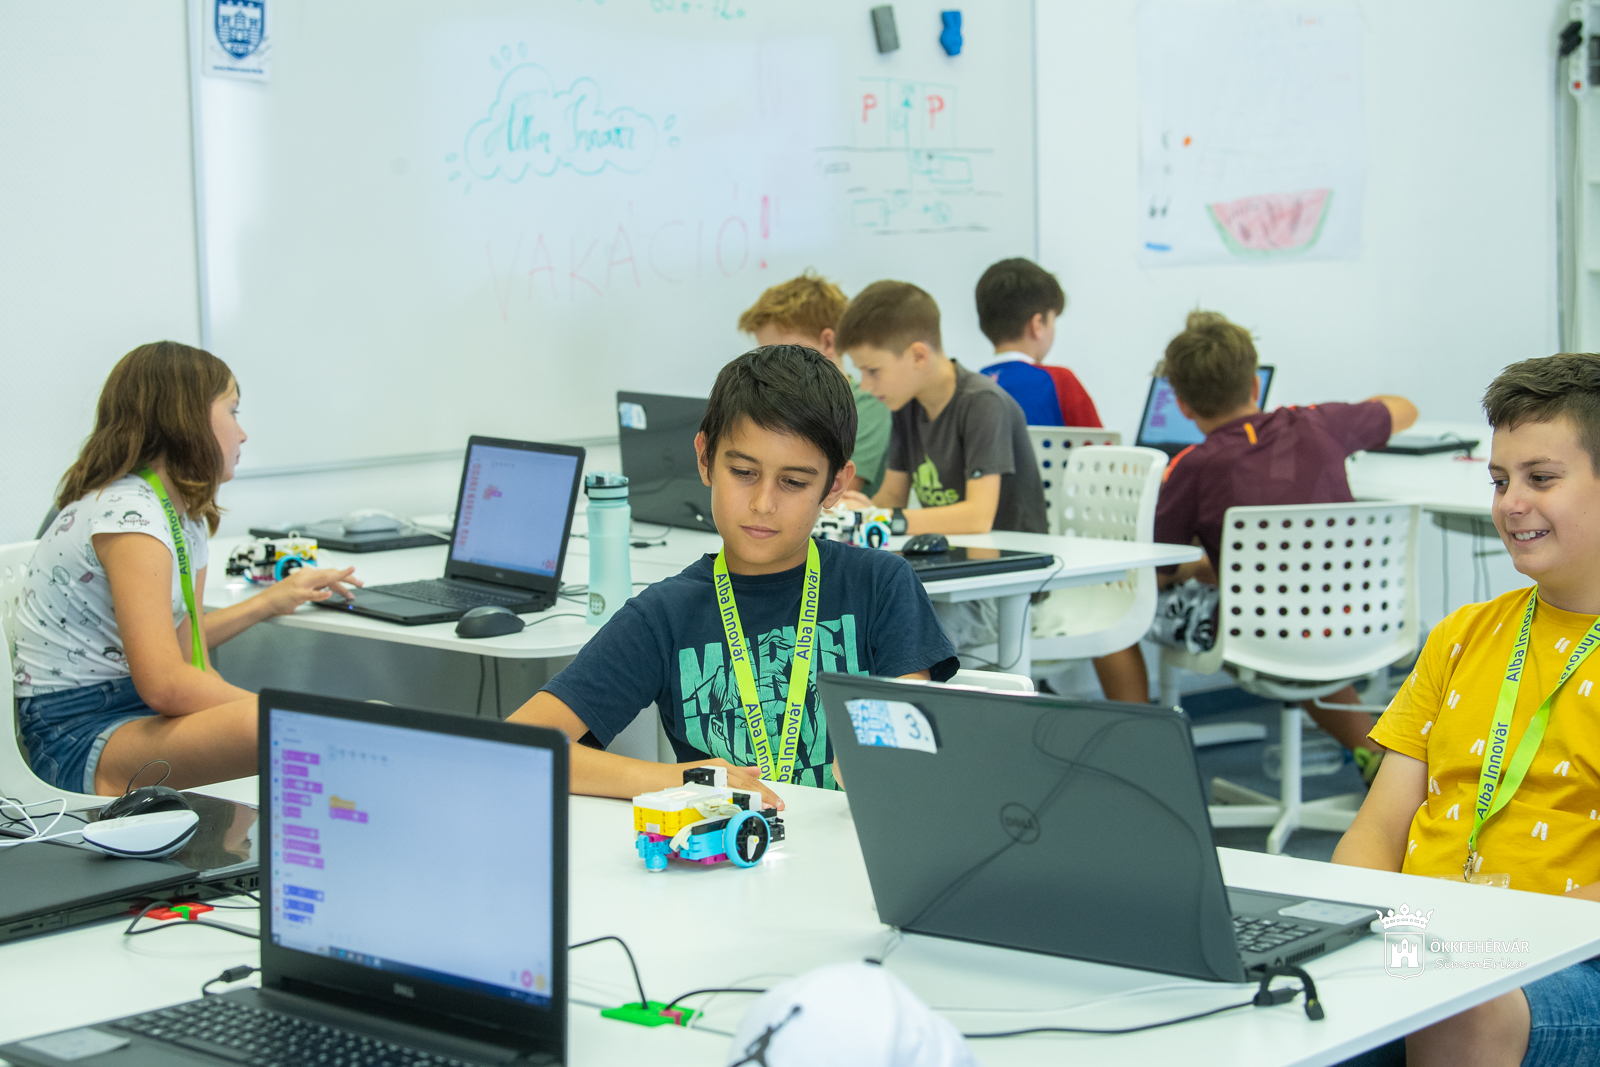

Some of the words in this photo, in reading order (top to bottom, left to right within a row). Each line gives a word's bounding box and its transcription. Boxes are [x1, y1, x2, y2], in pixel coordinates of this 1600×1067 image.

[862, 94, 878, 123] P
[927, 95, 945, 130] P
[715, 572, 730, 605] Alba
[722, 605, 748, 662] Innovár
[796, 626, 813, 660] Alba
[806, 568, 819, 623] Innovár
[1506, 649, 1524, 682] Alba
[745, 703, 762, 738] Alba
[756, 739, 772, 782] Innov
[780, 702, 802, 761] Innovár
[1484, 722, 1509, 780] Innovár
[1476, 783, 1494, 820] Alba
